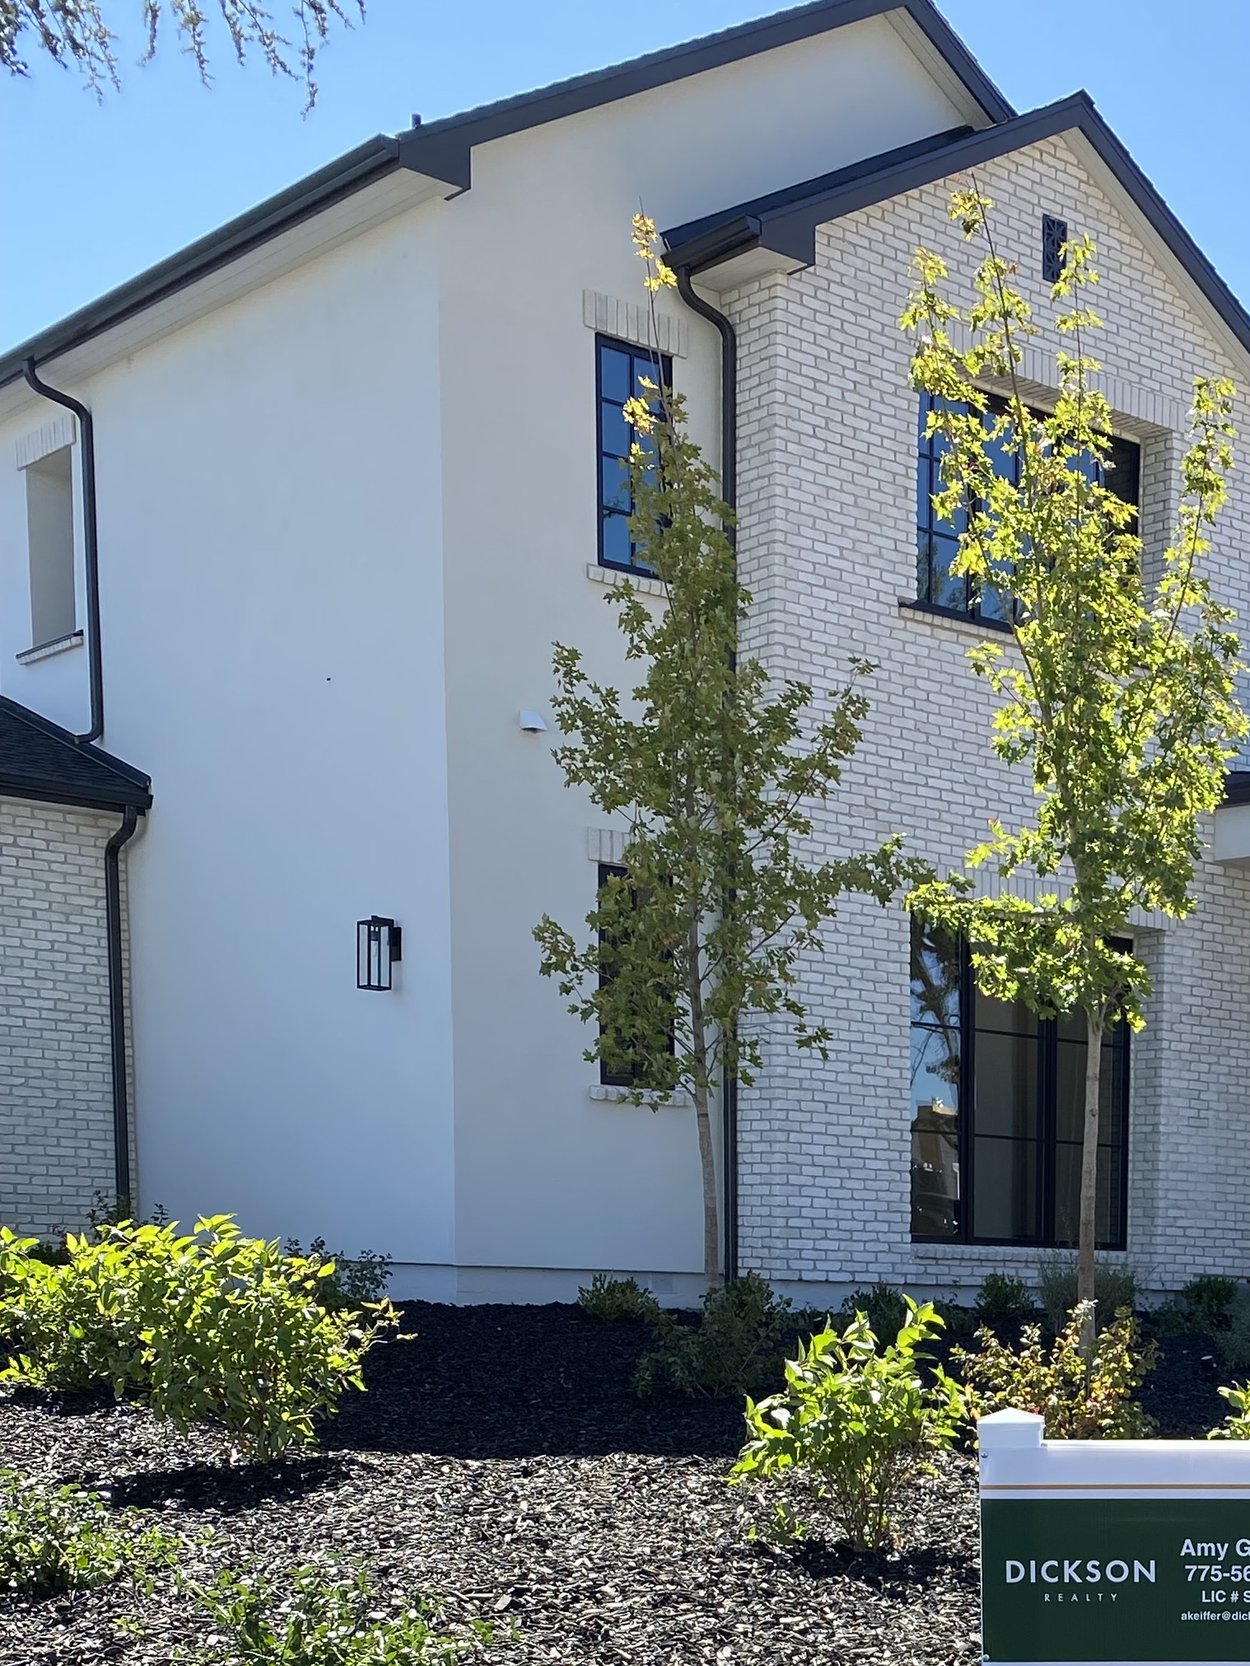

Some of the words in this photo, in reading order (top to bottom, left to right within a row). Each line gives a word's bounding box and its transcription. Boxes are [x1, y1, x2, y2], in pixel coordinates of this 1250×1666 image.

[1180, 1538, 1228, 1560] Amy
[1006, 1560, 1155, 1583] DICKSON
[1044, 1593, 1118, 1602] REALTY
[1201, 1590, 1226, 1604] LIC
[1230, 1590, 1239, 1604] #
